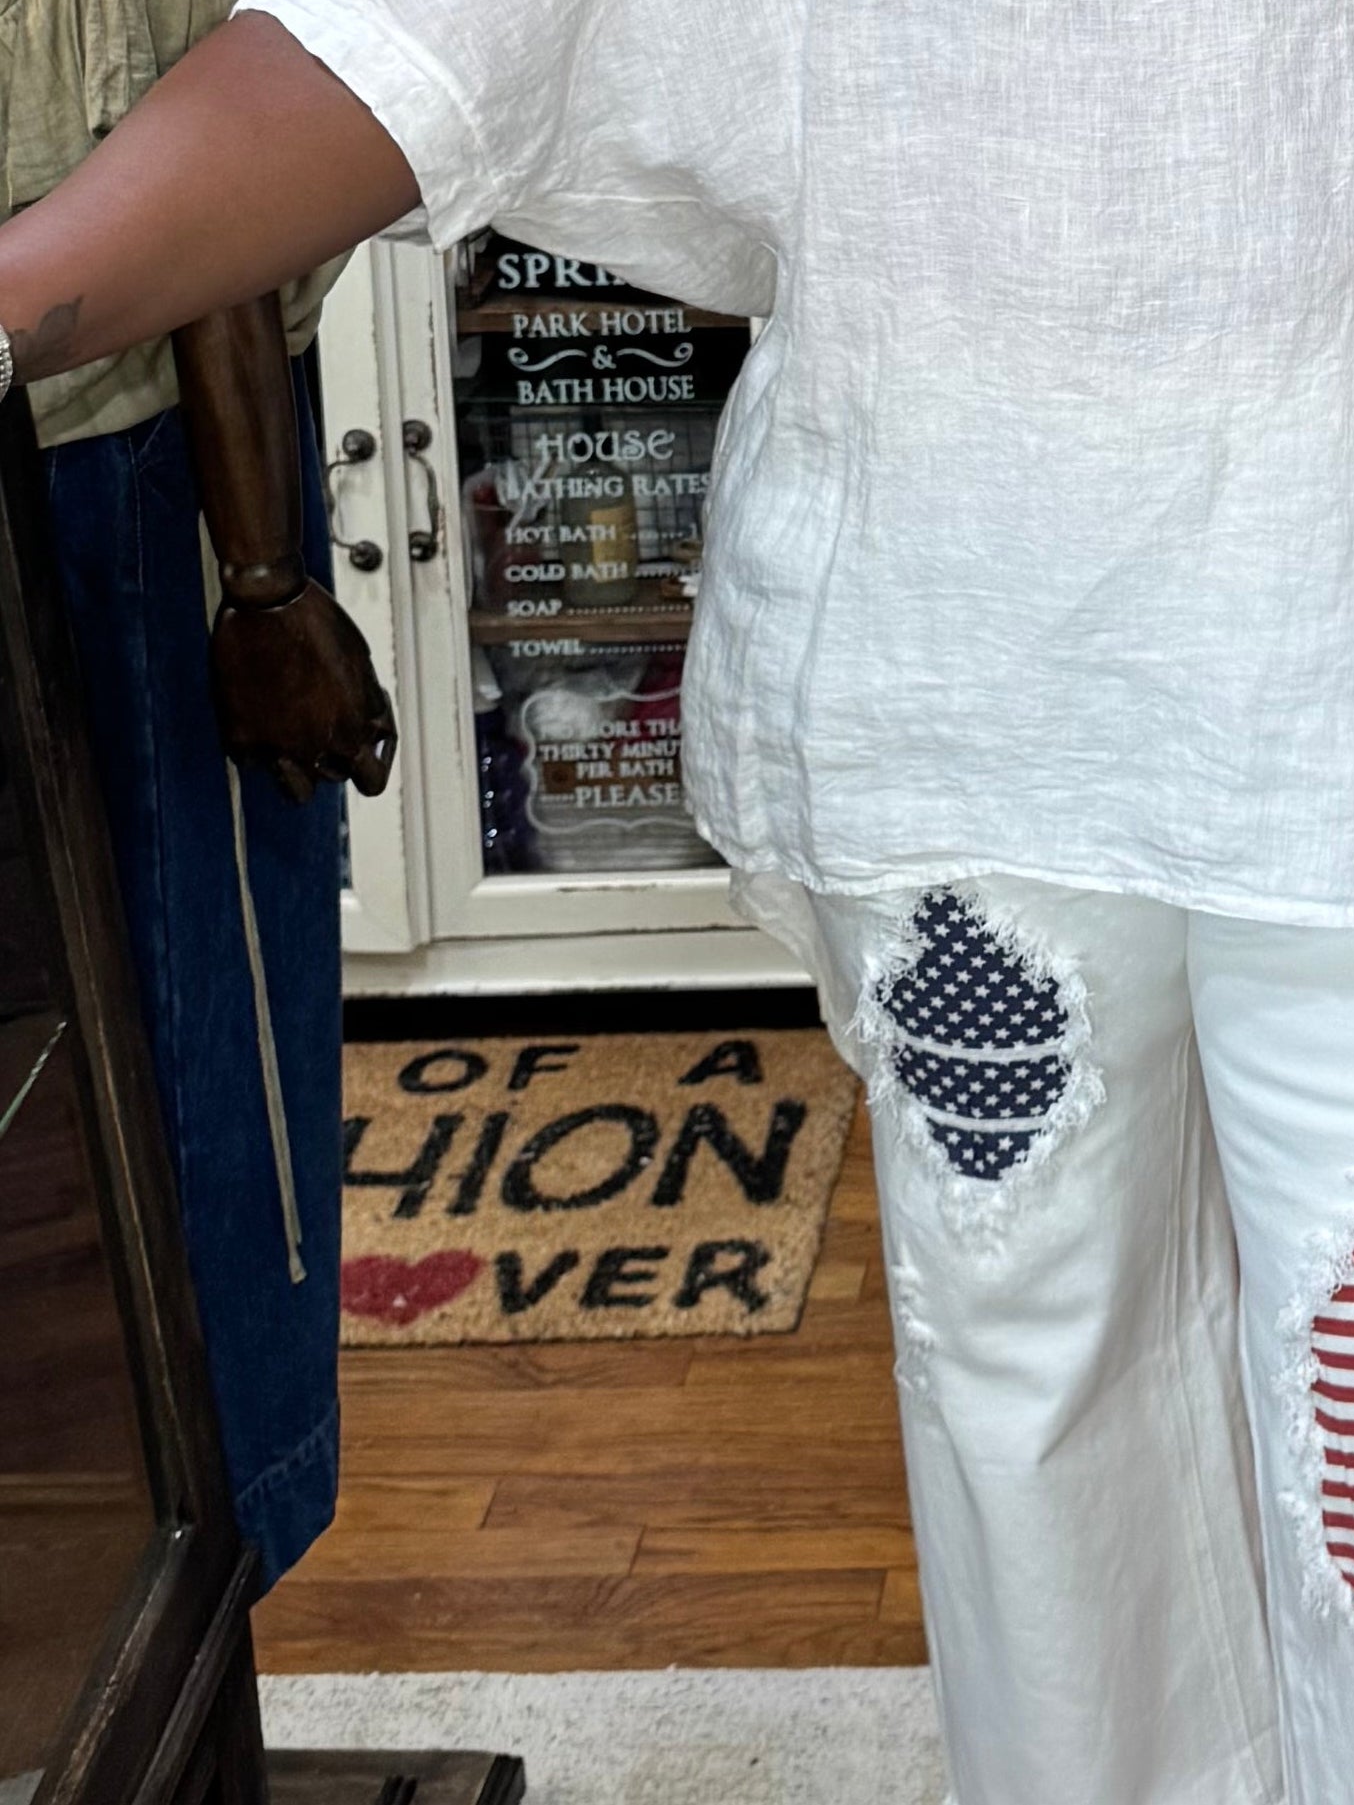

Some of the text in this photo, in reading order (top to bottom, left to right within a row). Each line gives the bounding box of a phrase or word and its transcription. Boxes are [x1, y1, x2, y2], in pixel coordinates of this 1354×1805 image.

[497, 253, 627, 289] SPRI
[513, 308, 693, 339] PARK HOTEL
[592, 344, 617, 370] &
[516, 374, 695, 405] BATH HOUSE
[631, 472, 711, 496] RATES
[505, 524, 554, 545] HOT
[559, 523, 617, 543] BATH
[504, 561, 629, 582] COLD BATH
[507, 598, 563, 617] SOAP
[509, 638, 585, 658] TOWEL
[538, 744, 615, 763] THIRTY
[576, 759, 675, 780] PER BATH
[574, 781, 680, 809] PLEASE
[397, 1039, 764, 1095] OF A
[494, 1239, 770, 1316] VER
